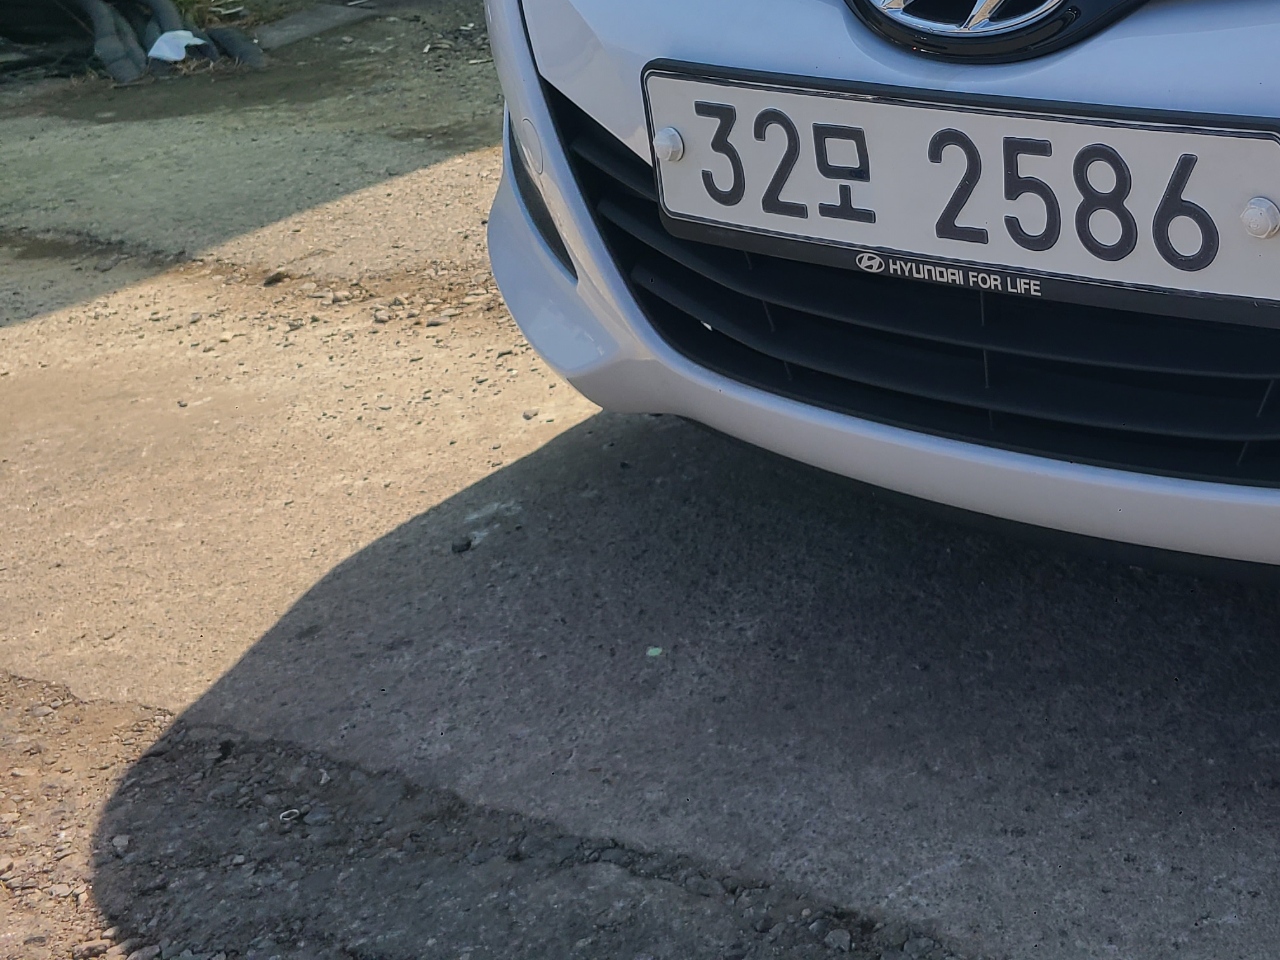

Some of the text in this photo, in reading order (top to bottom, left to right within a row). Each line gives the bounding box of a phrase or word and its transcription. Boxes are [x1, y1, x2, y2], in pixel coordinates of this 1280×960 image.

[694, 100, 1220, 272] 32모 2586
[888, 259, 1042, 297] HYUNDAI FOR LIFE
